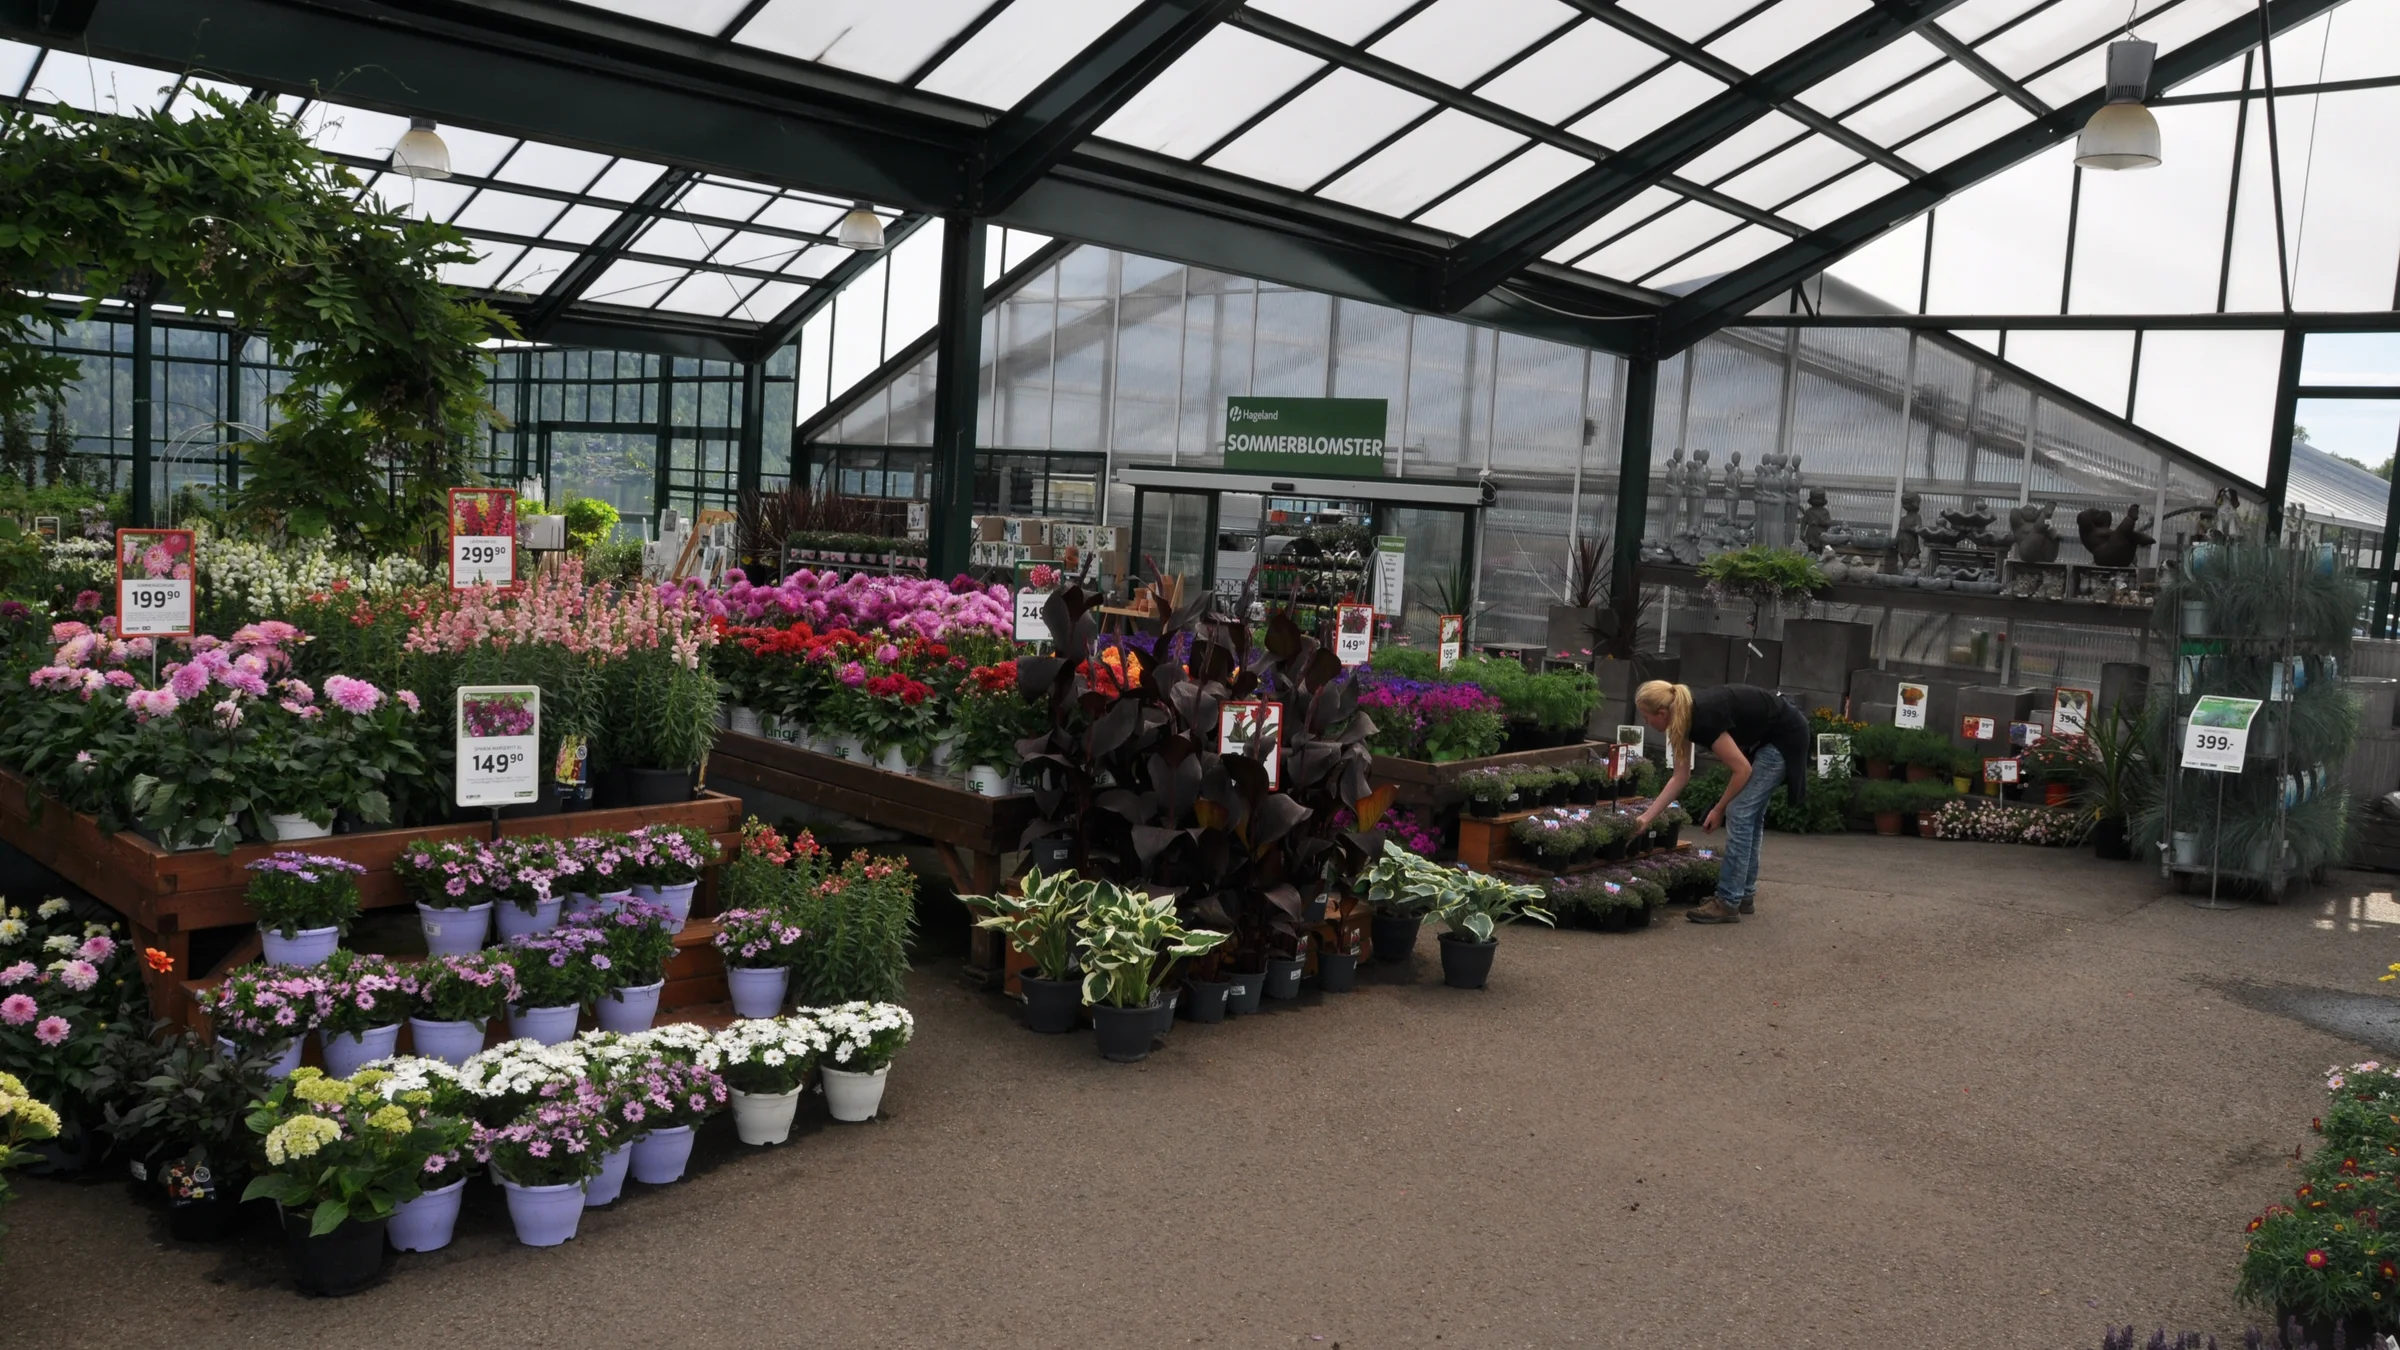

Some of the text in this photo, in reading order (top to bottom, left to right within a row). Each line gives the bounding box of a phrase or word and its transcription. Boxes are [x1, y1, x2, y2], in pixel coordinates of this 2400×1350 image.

[1243, 409, 1279, 422] Hageland
[1227, 434, 1383, 457] SOMMERBLOMSTER
[2196, 734, 2234, 751] 399,-
